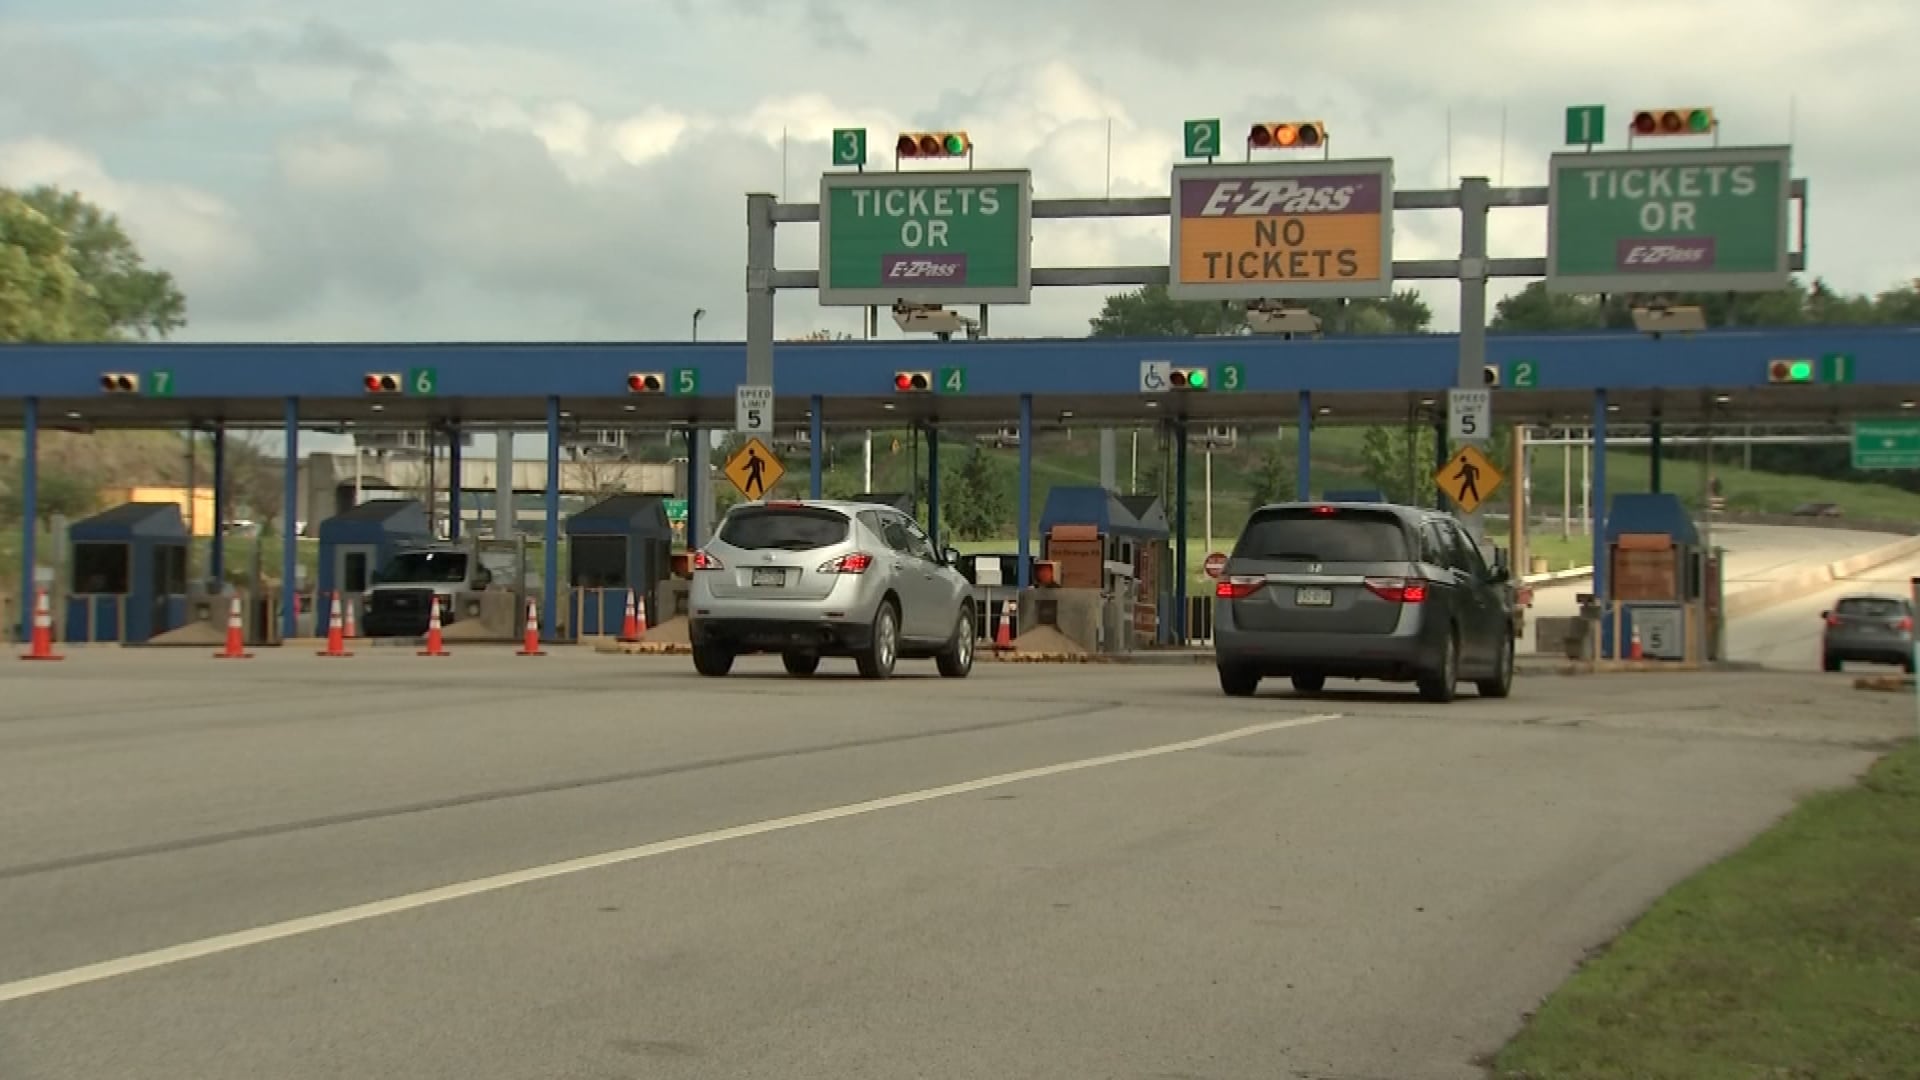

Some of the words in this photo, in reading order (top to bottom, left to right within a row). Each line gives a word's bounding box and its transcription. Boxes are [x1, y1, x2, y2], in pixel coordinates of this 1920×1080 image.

[1581, 110, 1590, 139] 1
[842, 131, 858, 161] 3
[1193, 123, 1212, 153] 2
[1583, 166, 1757, 199] TICKETS
[852, 188, 1000, 217] TICKETS
[1201, 180, 1356, 217] E-ZPass
[1639, 202, 1696, 232] OR
[901, 220, 949, 248] OR
[1254, 219, 1305, 247] NO
[888, 261, 957, 278] E-ZPass
[1202, 250, 1359, 279] TICKETS
[946, 370, 962, 392] 4
[1224, 367, 1238, 390] 3
[1515, 364, 1533, 386] 2
[1835, 357, 1844, 381] 1
[154, 372, 169, 393] 7
[416, 371, 432, 394] 6
[679, 370, 695, 394] 5
[739, 389, 771, 400] SPEED
[742, 400, 767, 409] LIMIT
[1453, 393, 1487, 403] SPEED
[748, 410, 761, 429] 5
[1462, 415, 1476, 434] 5
